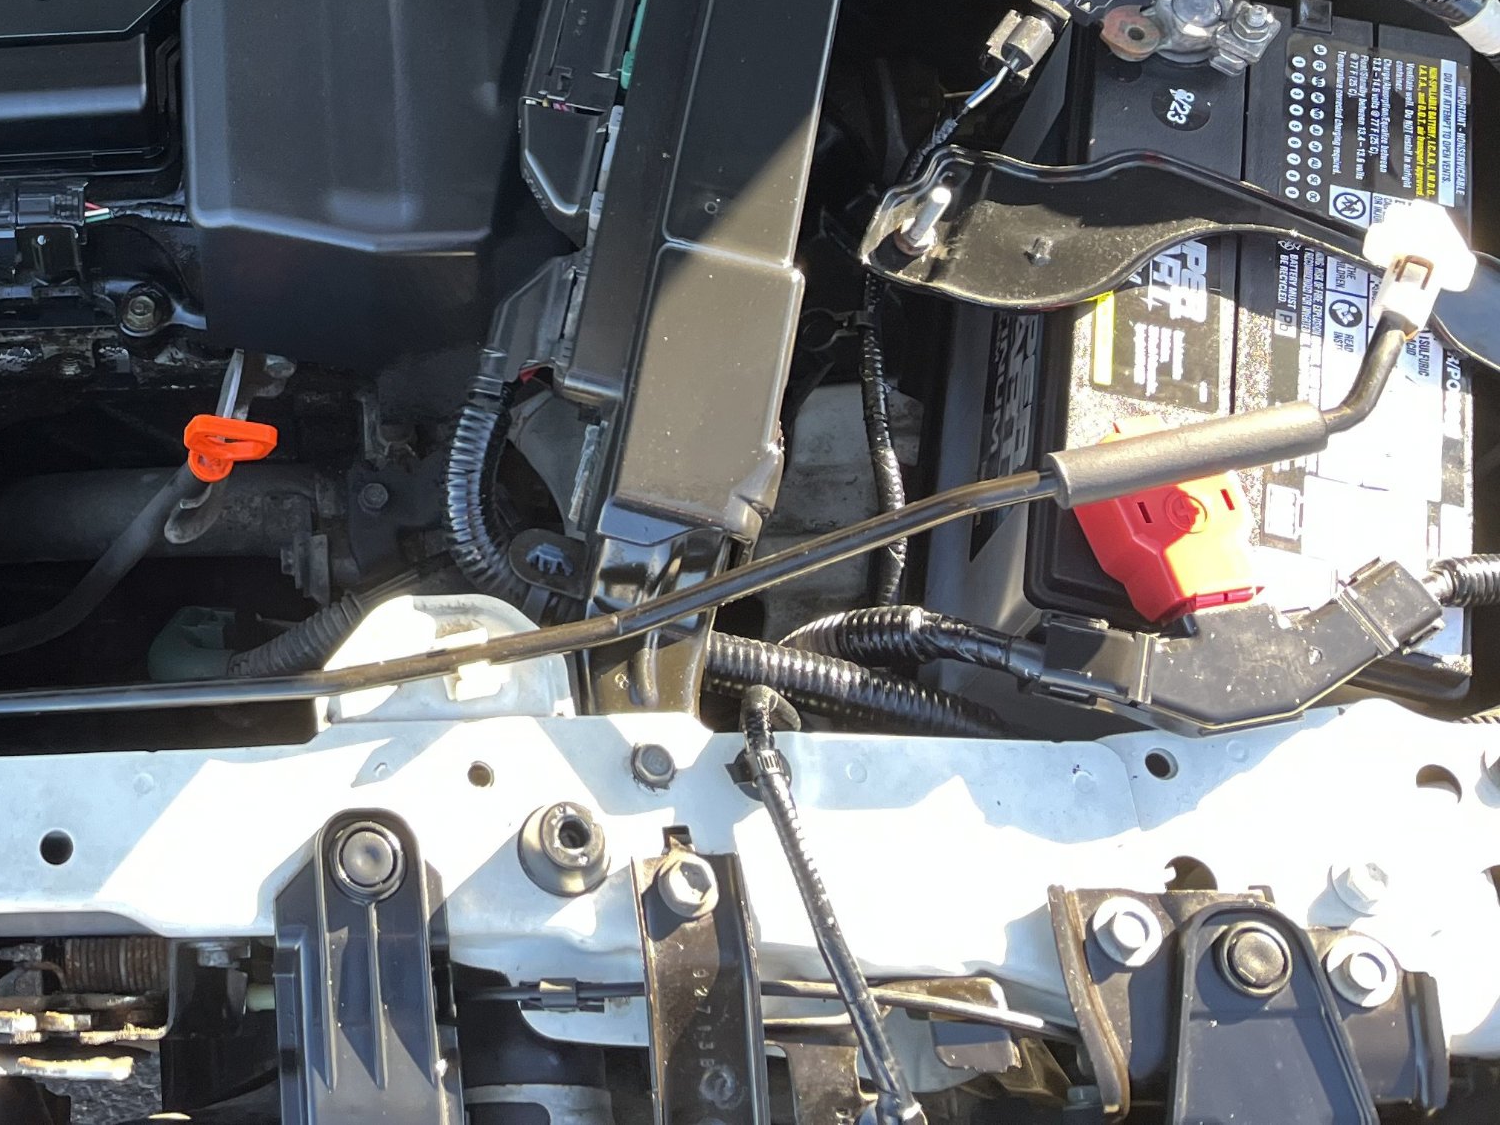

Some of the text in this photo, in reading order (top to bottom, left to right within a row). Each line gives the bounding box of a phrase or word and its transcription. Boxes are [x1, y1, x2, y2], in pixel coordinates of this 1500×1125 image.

[1395, 61, 1405, 92] container.
[1406, 63, 1415, 90] Ventilate
[1371, 93, 1379, 109] volts
[1406, 92, 1414, 107] well.
[1418, 92, 1426, 104] and
[1457, 86, 1467, 127] IMPORTANT
[1332, 51, 1346, 175] Temperature corrected charging required.
[1358, 98, 1367, 125] between
[1405, 109, 1414, 118] Do
[1403, 120, 1413, 134] NOT
[1442, 73, 1453, 183] DO NOT ATTEMPT TO OPEN VENTS.
[1404, 135, 1413, 155] install
[1380, 146, 1389, 172] between
[1456, 133, 1466, 195] NONSERVICEABLE
[1356, 164, 1365, 180] volts
[1402, 164, 1412, 188] airtight
[1374, 196, 1382, 204] OR
[1278, 255, 1288, 303] BE RECYCLED.
[1288, 254, 1298, 309] BATTERY MUST
[1304, 252, 1314, 293] RECOMMENDED
[1315, 268, 1324, 280] RISK
[1347, 267, 1356, 280] THE
[1303, 294, 1312, 305] FOR
[1279, 314, 1292, 331] Pb
[1302, 306, 1311, 332] INVERTED
[1312, 305, 1322, 335] EXPLOSION
[1344, 334, 1354, 352] READ
[1418, 339, 1430, 377] SULFURIC
